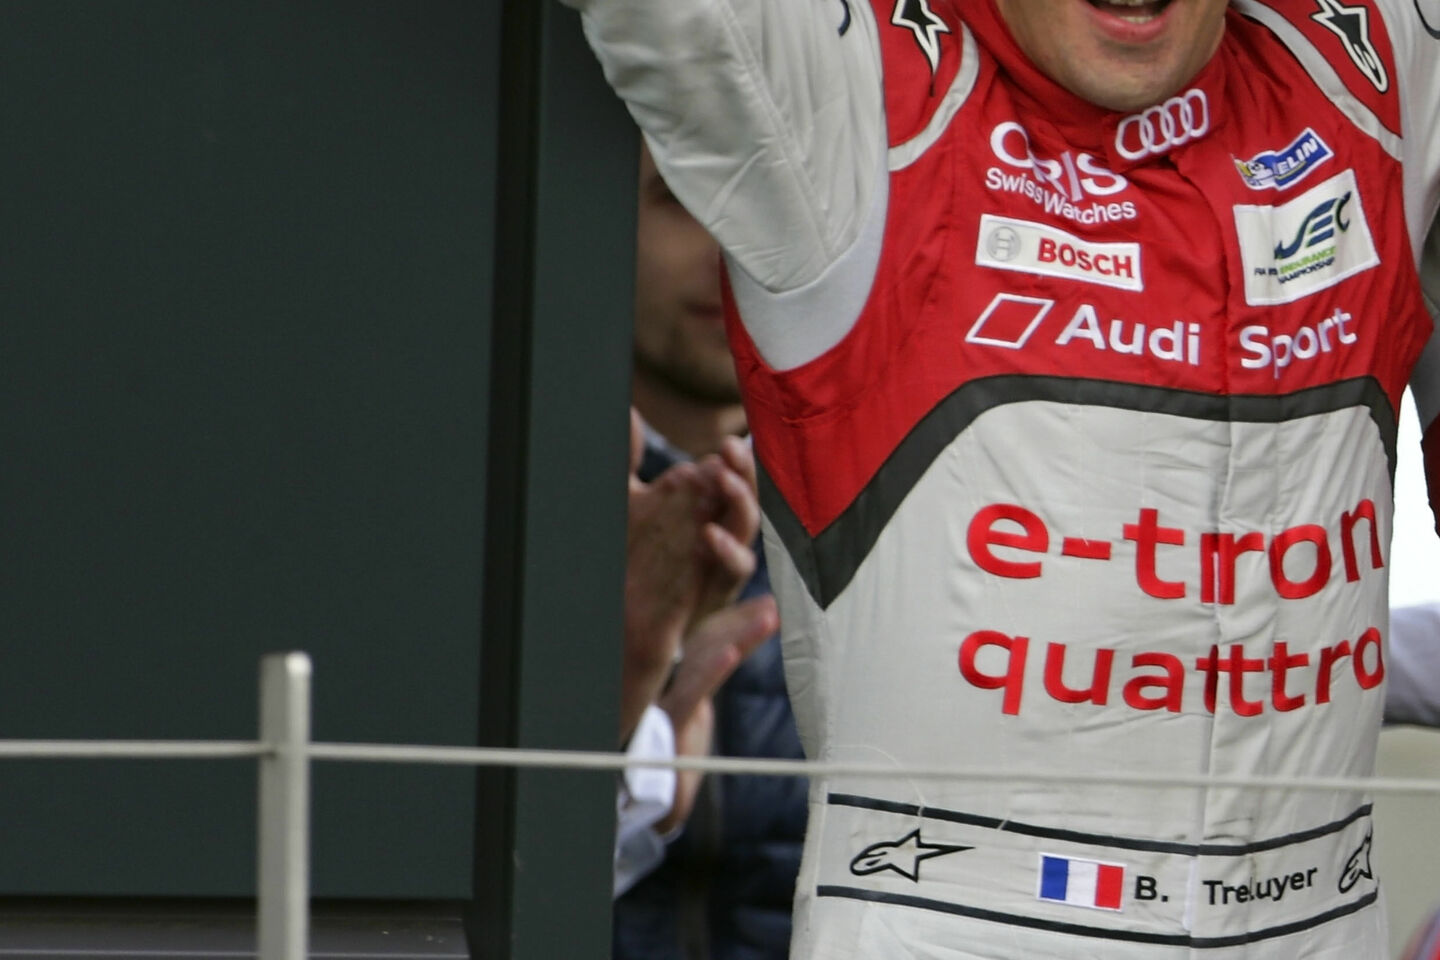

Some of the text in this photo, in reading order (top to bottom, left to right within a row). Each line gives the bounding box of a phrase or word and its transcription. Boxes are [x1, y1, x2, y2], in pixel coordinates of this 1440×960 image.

[990, 121, 1128, 202] ORIS
[1037, 237, 1135, 279] BOSCH
[1055, 303, 1358, 380] Audi Sport
[965, 498, 1385, 606] e-tron
[958, 627, 1386, 718] quattro
[1134, 875, 1169, 903] B.
